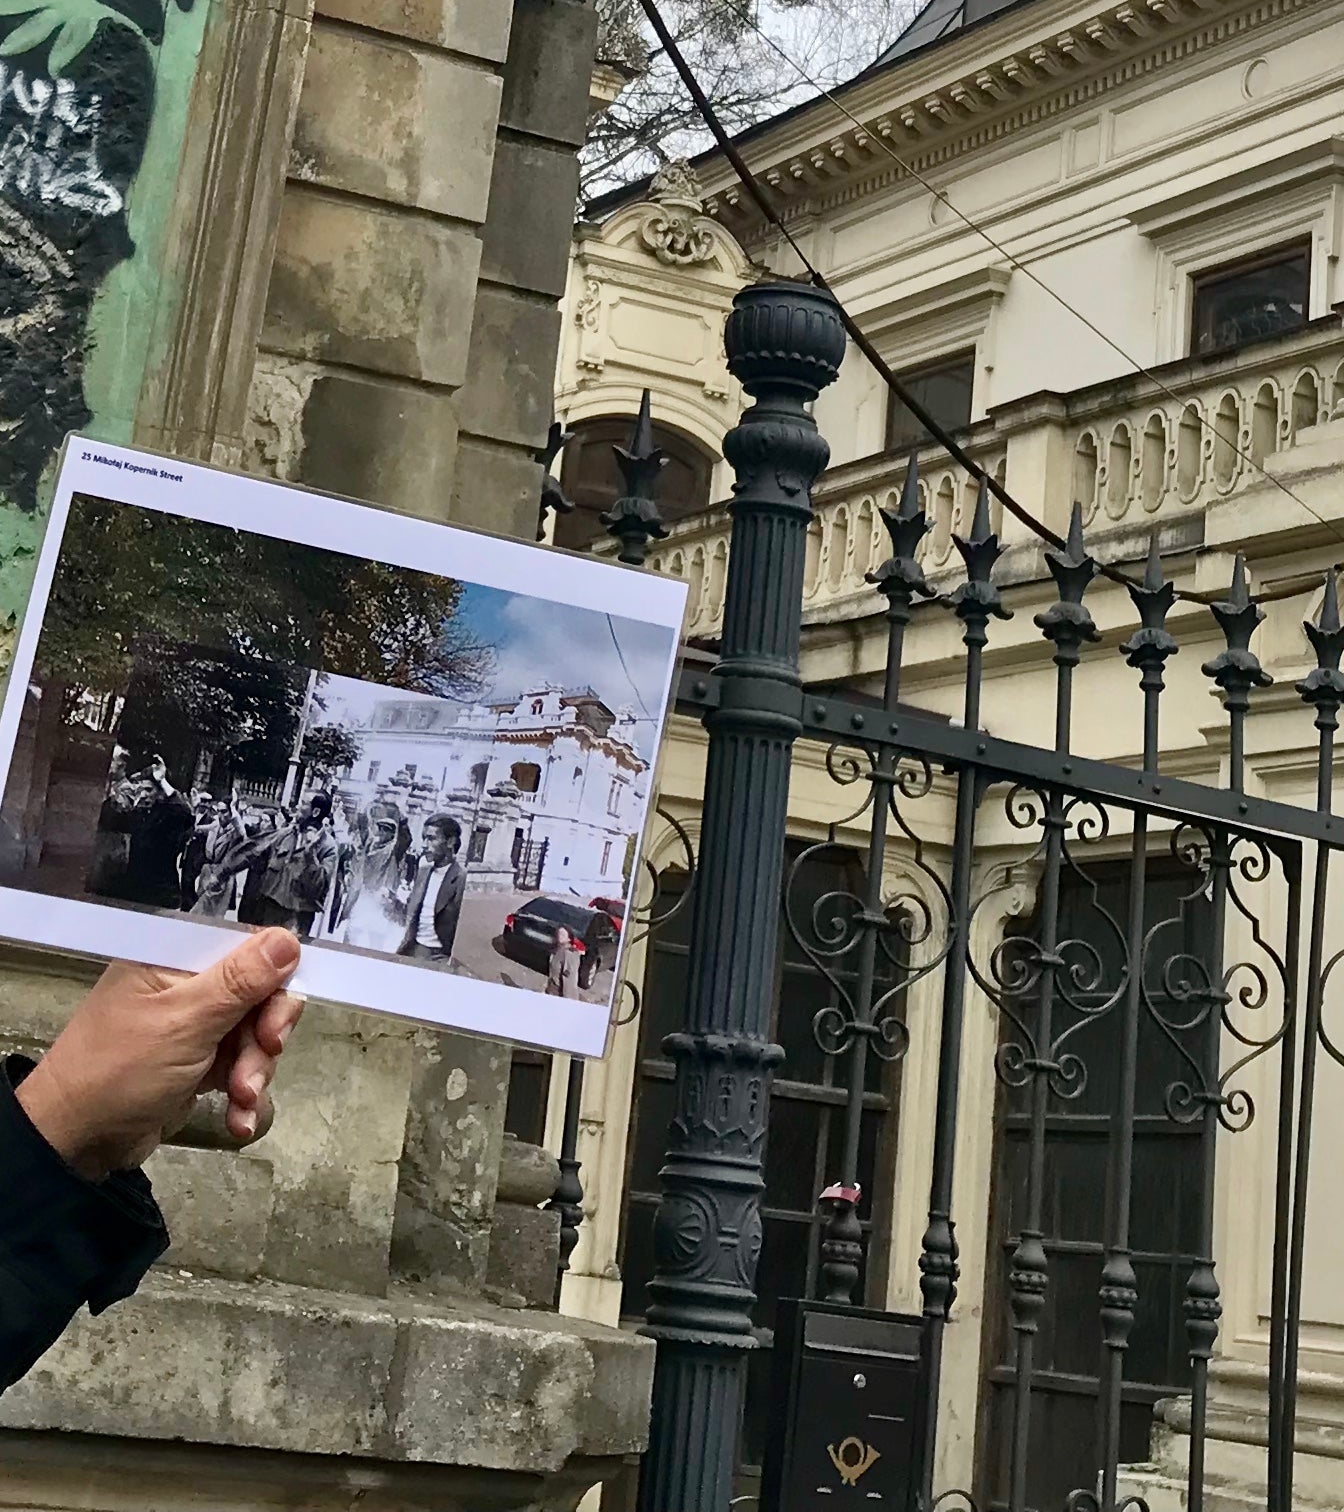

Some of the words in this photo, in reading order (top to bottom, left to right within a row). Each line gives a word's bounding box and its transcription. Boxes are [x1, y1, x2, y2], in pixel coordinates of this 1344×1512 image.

[81, 452, 91, 461] 25
[124, 462, 158, 476] Kopernik
[159, 470, 183, 482] Street
